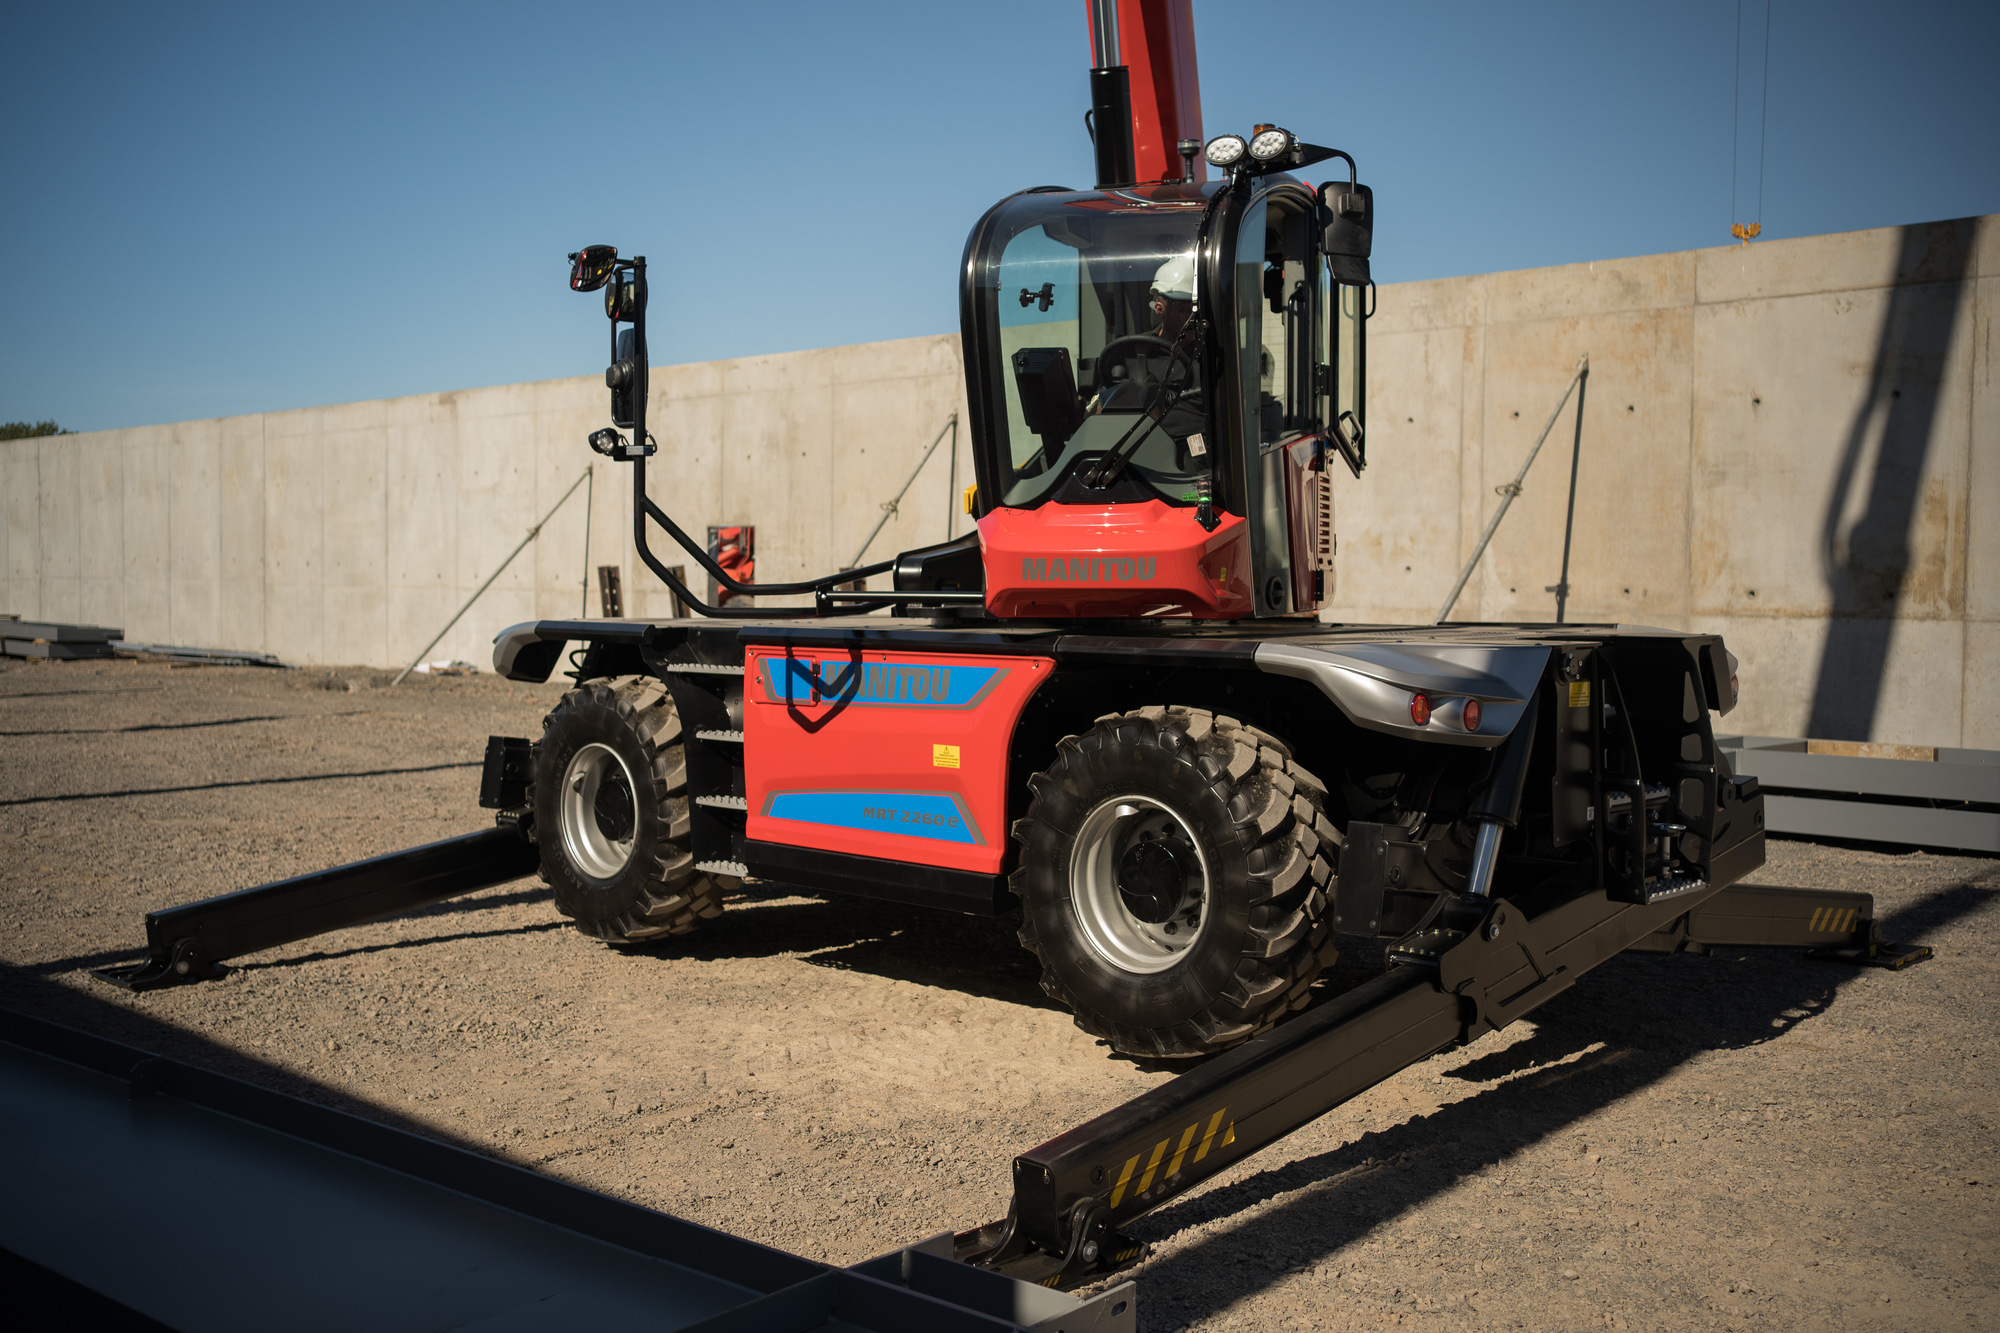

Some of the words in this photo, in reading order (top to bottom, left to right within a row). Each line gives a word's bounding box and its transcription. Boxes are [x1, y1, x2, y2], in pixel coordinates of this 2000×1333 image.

[1022, 557, 1156, 581] MANITOU
[824, 664, 951, 701] MANITOU
[863, 806, 898, 821] MRT
[900, 811, 945, 826] 2260
